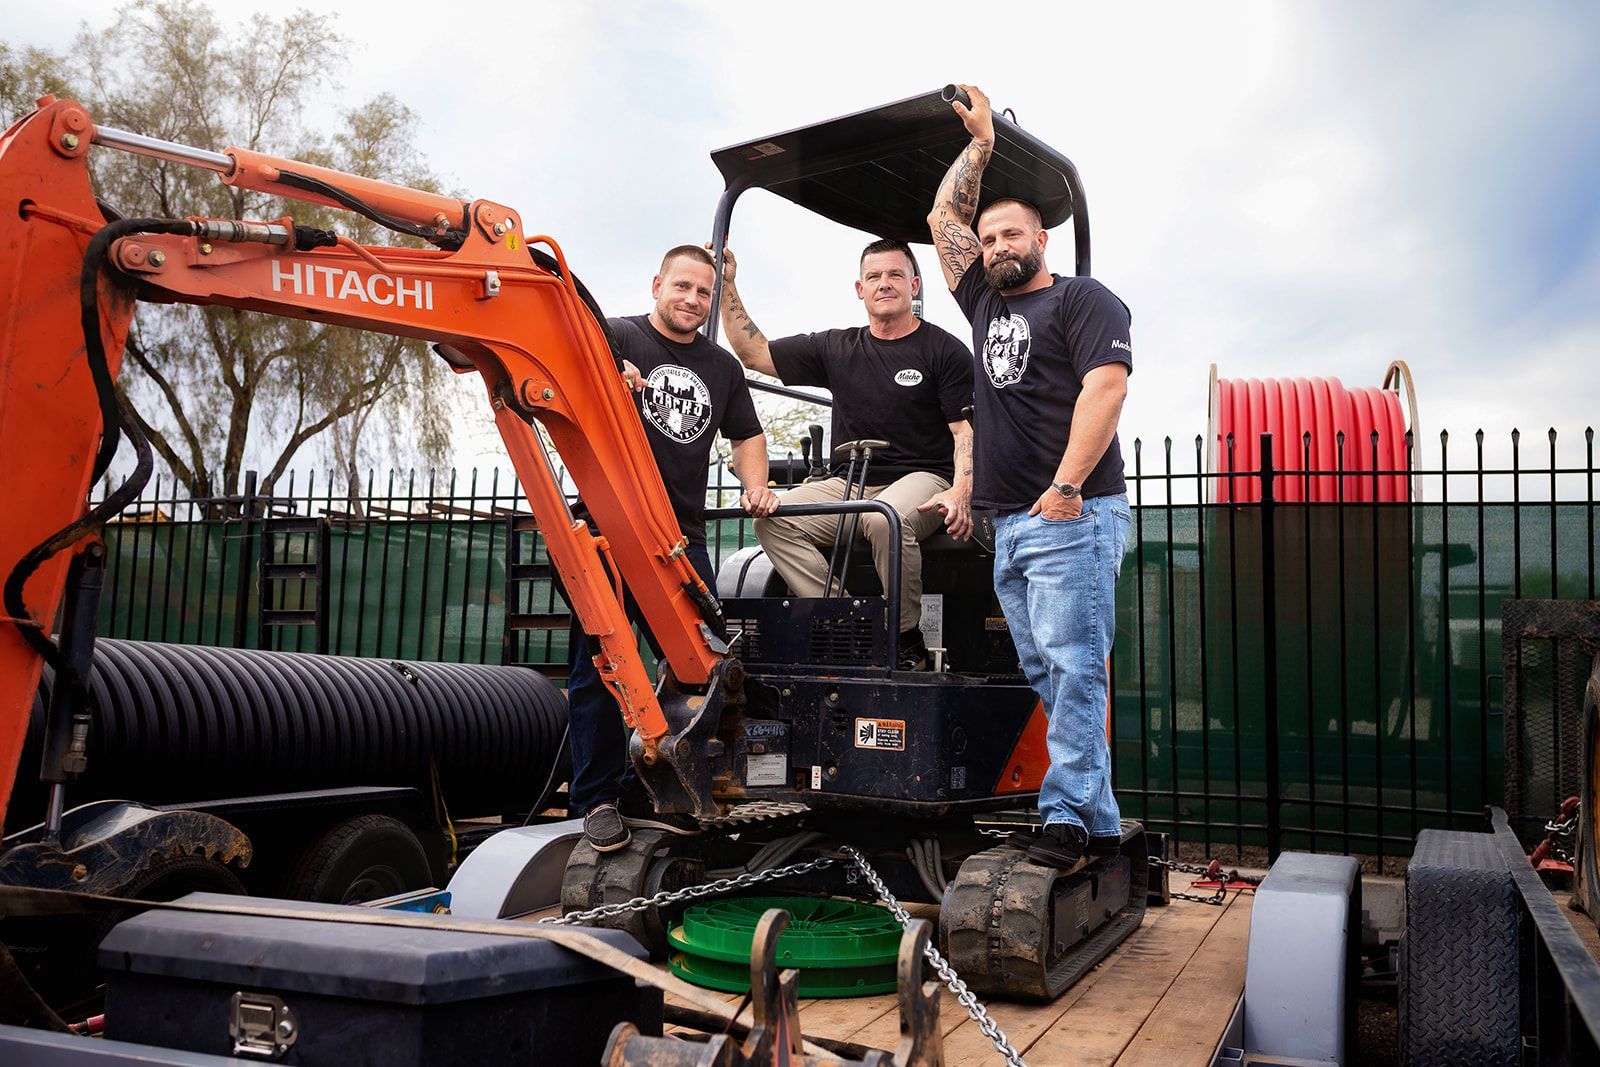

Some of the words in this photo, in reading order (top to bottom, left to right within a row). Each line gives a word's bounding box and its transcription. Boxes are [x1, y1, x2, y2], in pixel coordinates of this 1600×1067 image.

[271, 259, 434, 311] HITACHI
[652, 370, 666, 383] UNITED
[666, 368, 681, 377] STATES
[690, 376, 707, 398] AMERICA
[652, 389, 704, 417] MACHO
